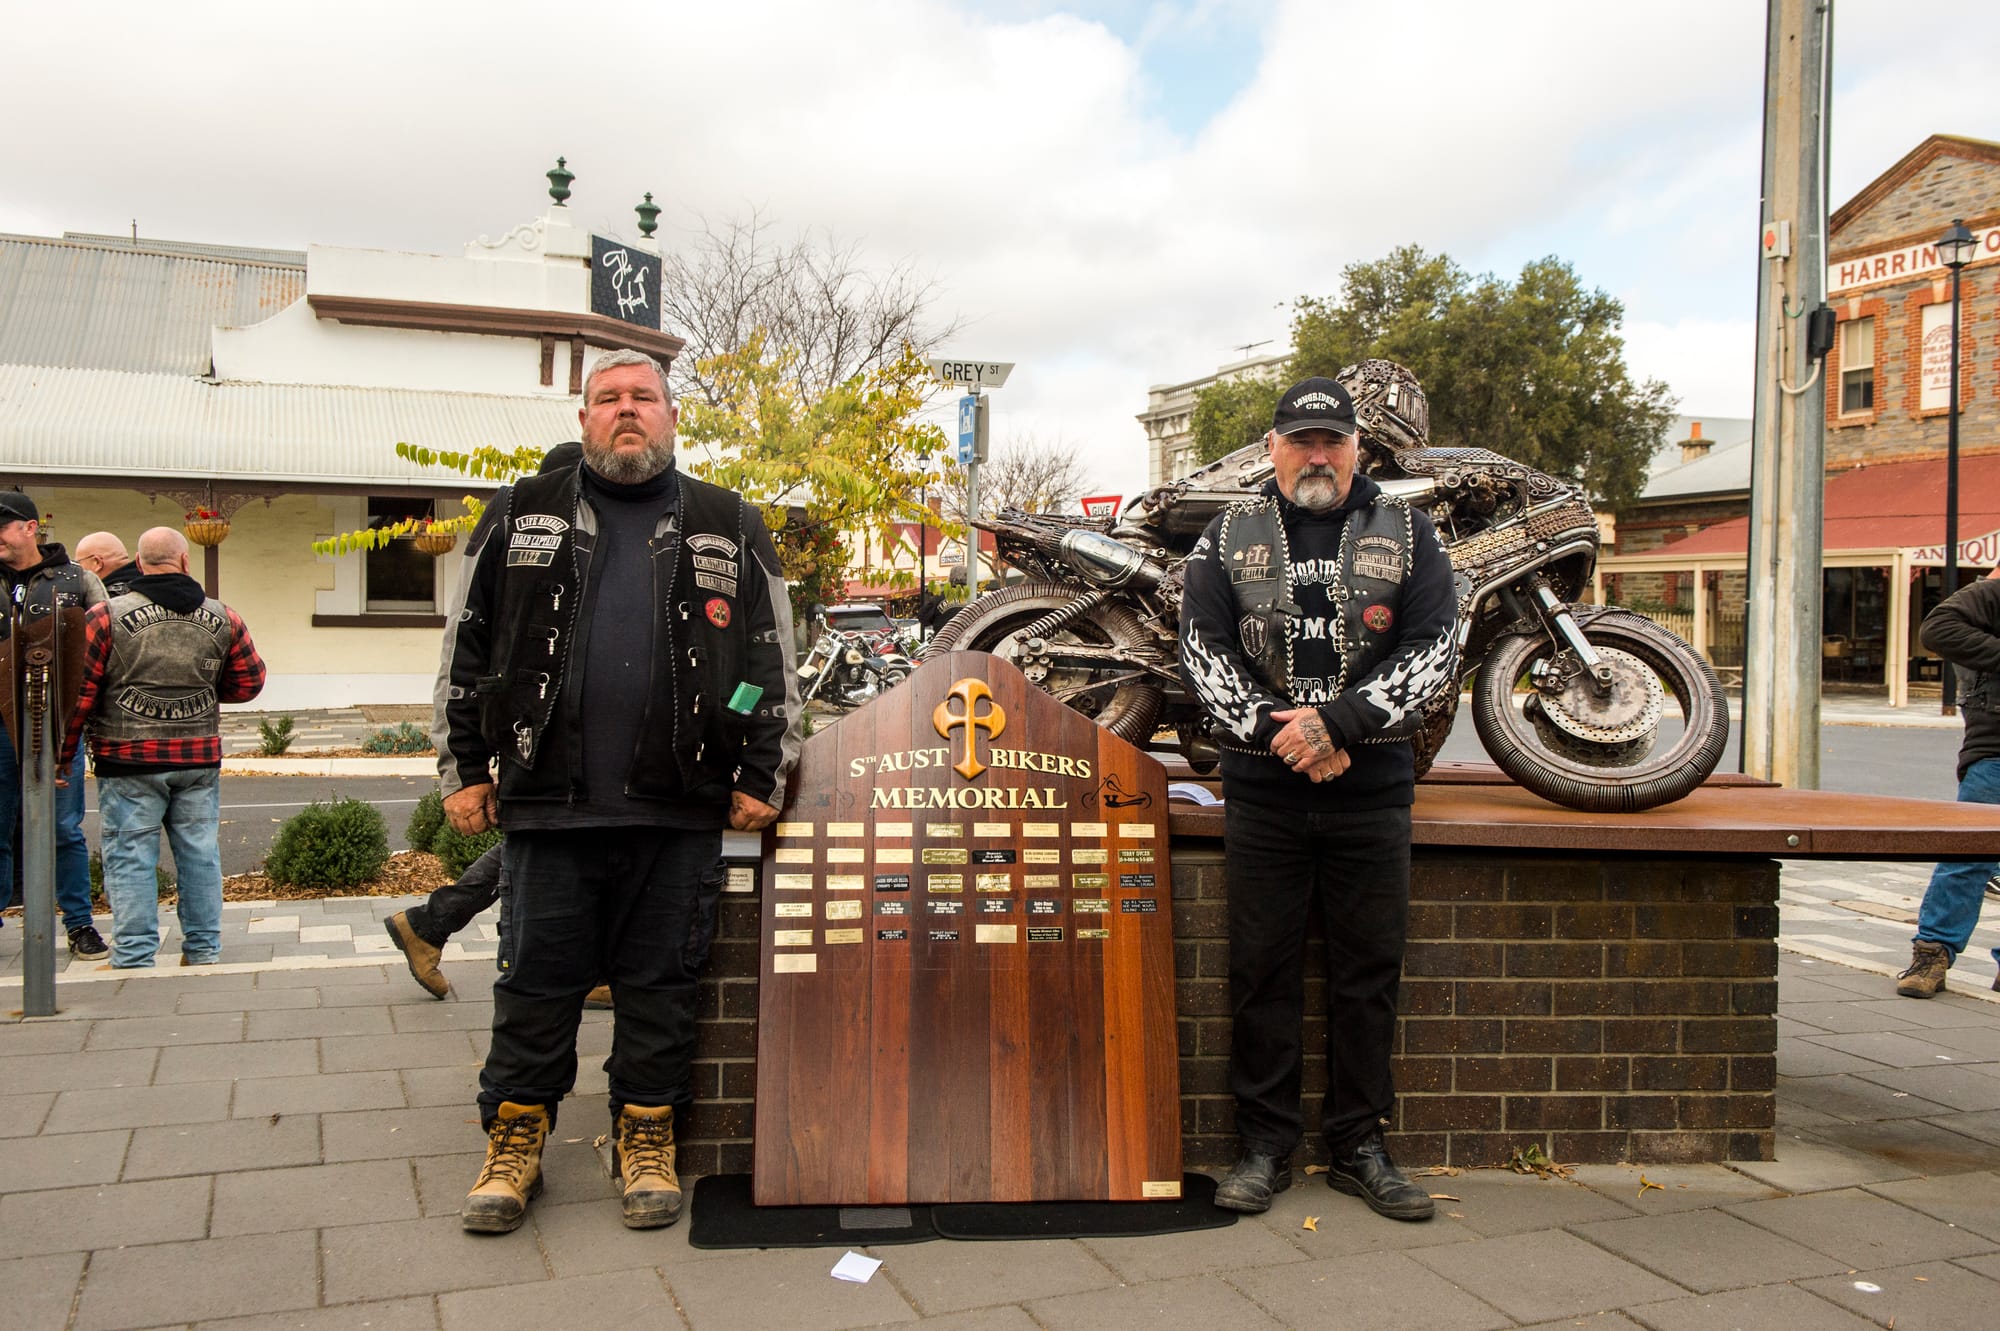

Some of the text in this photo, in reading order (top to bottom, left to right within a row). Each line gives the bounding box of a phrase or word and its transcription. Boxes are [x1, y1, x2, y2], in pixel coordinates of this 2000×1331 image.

[942, 362, 1000, 382] GREY ST
[1293, 392, 1340, 408] LONGRIDERS
[1305, 402, 1327, 410] CMC
[1092, 505, 1111, 515] GIVE
[513, 535, 558, 547] ROAD CAPTAIN
[1355, 536, 1401, 551] LONGRIDERS
[1913, 532, 1999, 565] ANIQU
[1356, 552, 1390, 565] CHRISTIAN
[1241, 567, 1269, 581] CHILLY
[1355, 564, 1382, 578] MURRAY
[123, 688, 214, 719] AUSTRALIA
[876, 748, 950, 773] AUST
[990, 748, 1092, 779] BIKERS
[869, 787, 1069, 810] MEMORIAL
